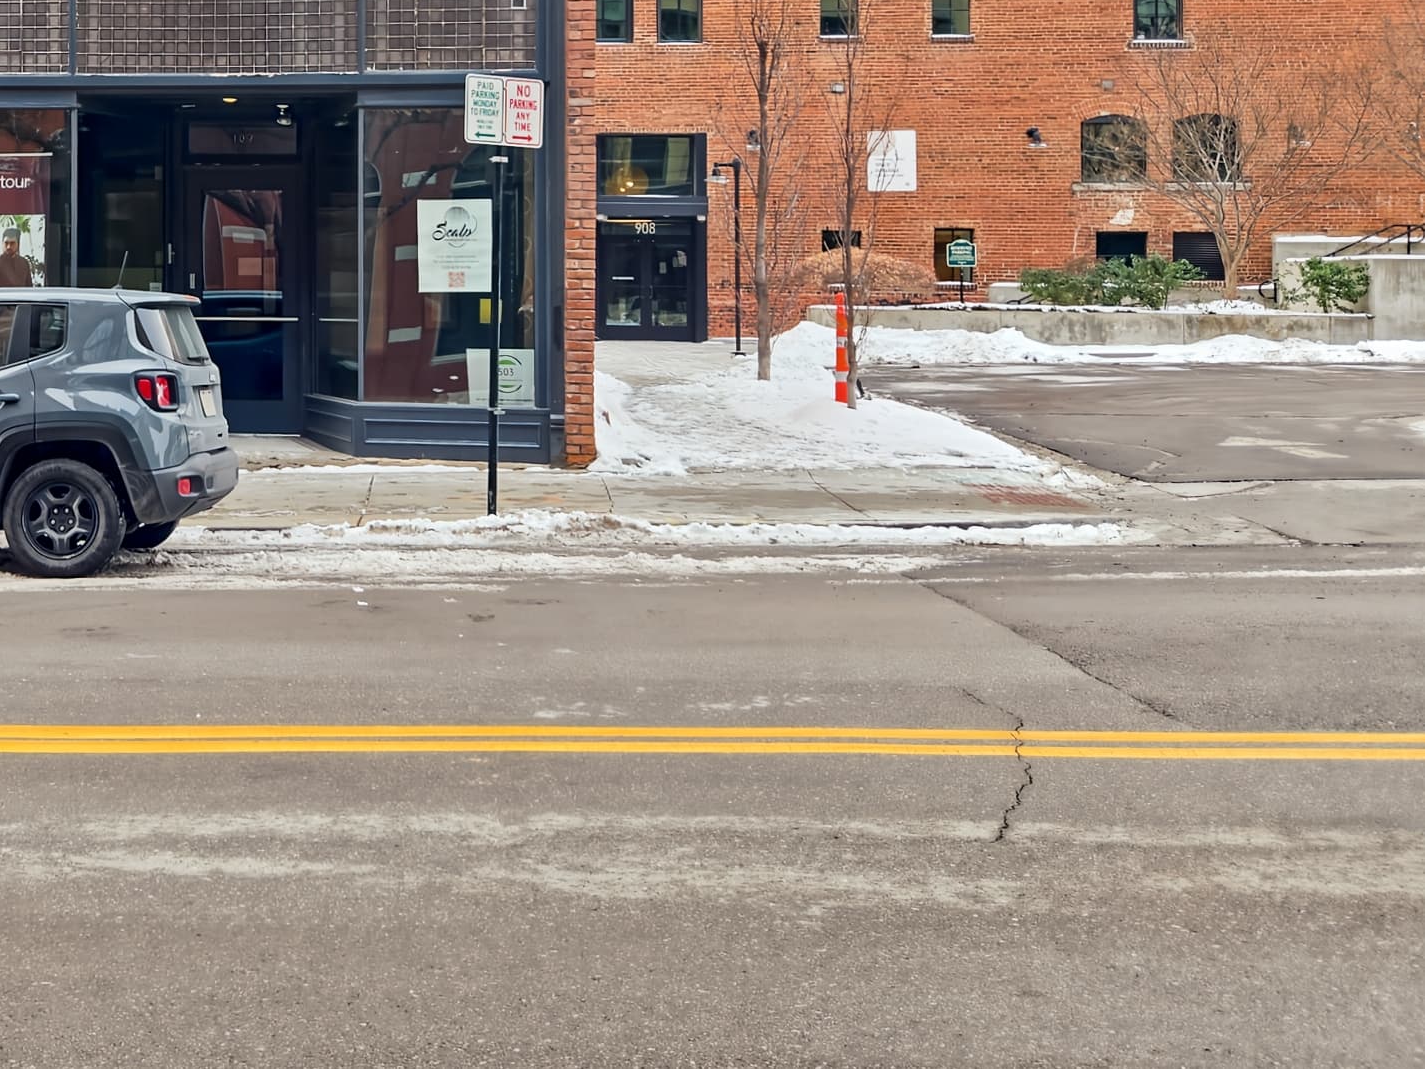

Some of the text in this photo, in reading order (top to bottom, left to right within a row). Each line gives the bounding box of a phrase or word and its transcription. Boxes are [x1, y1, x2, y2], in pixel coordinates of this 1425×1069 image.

[477, 81, 494, 90] PAID
[516, 84, 531, 98] NO
[470, 89, 500, 100] PARKING
[472, 99, 497, 108] MONDAY
[509, 98, 538, 111] PARKING
[470, 107, 499, 117] TO FRIDAY
[516, 112, 530, 121] ANY
[514, 121, 531, 132] TIME
[0, 175, 31, 189] tour
[635, 222, 656, 235] 908
